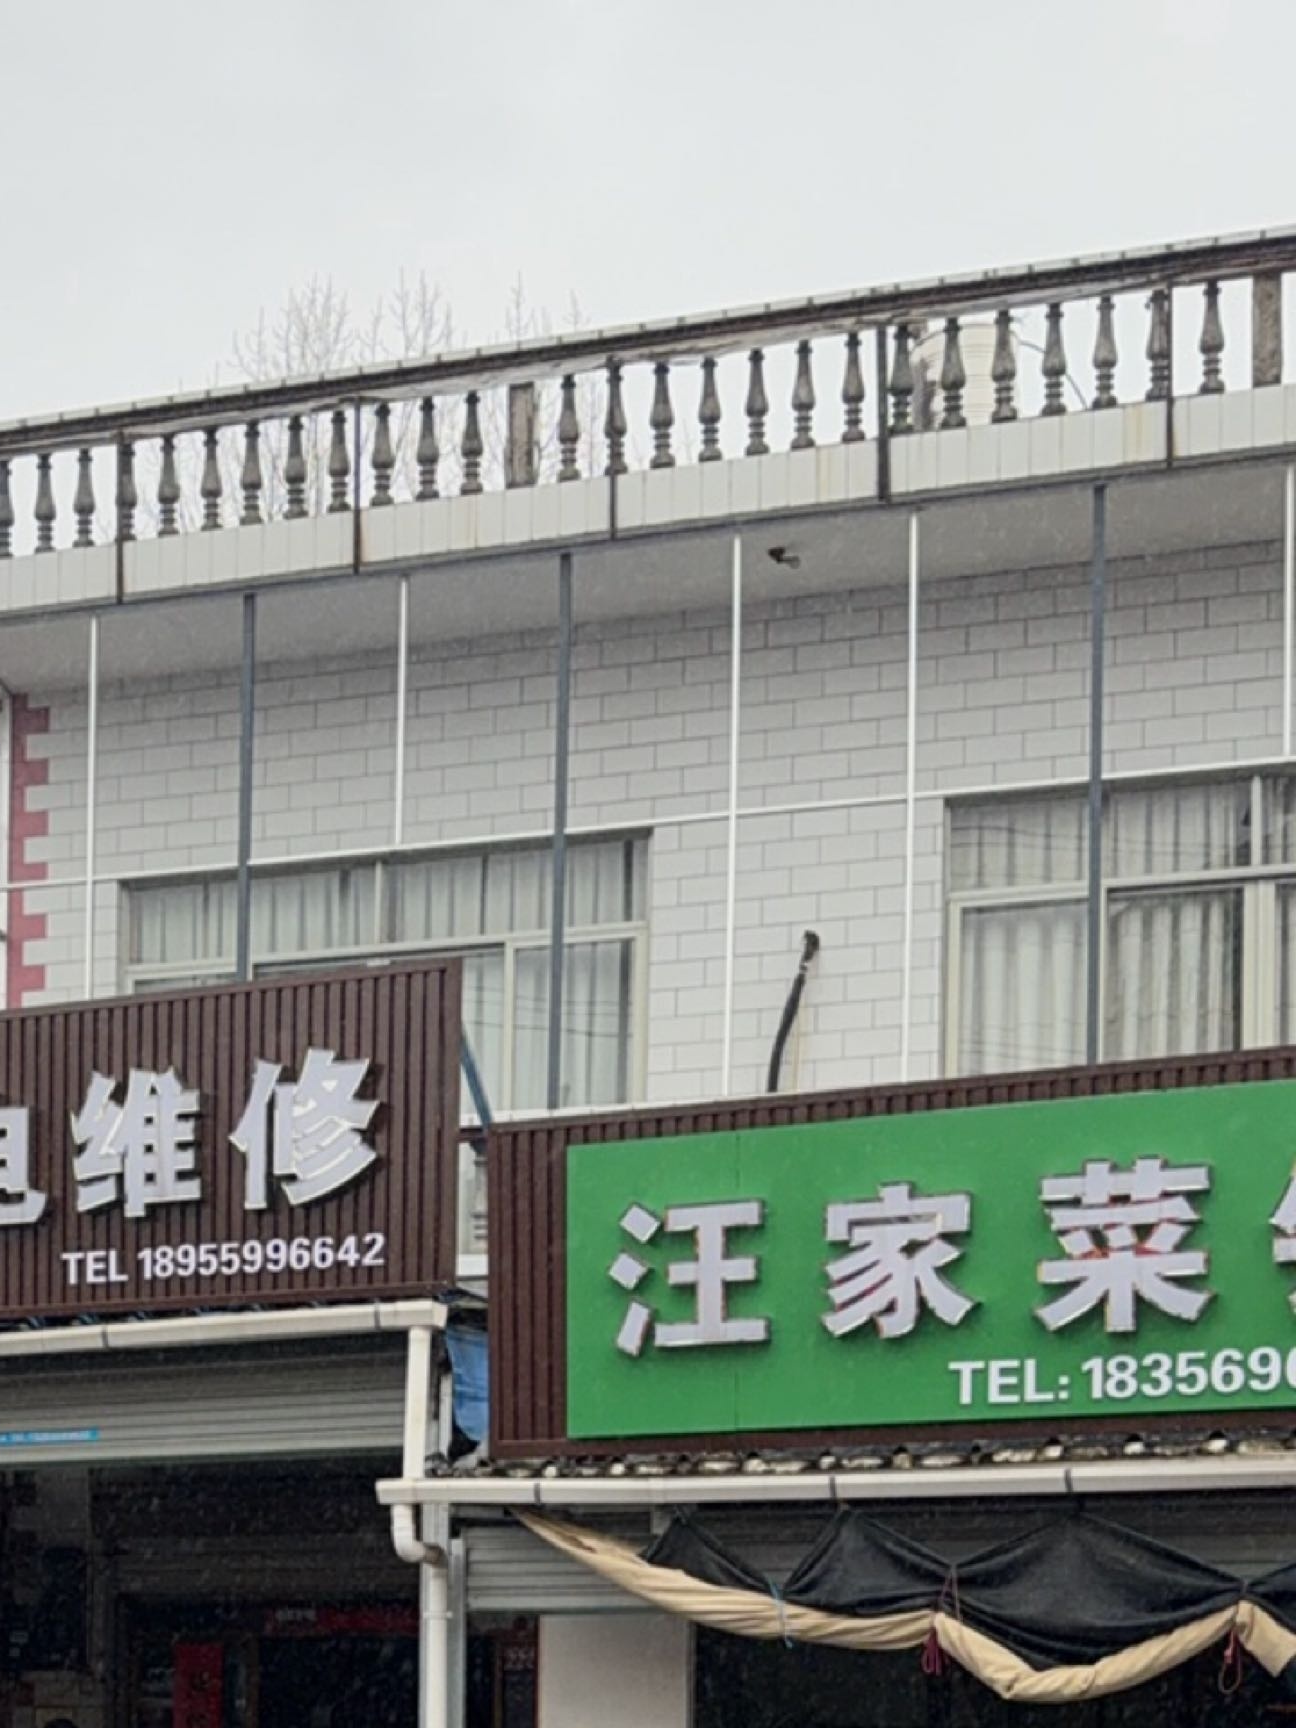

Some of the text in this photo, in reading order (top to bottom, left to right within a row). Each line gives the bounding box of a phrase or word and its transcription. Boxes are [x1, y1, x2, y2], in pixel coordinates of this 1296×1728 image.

[61, 1231, 386, 1285] TEL 18955996642
[607, 1155, 1296, 1358] 汪家菜
[948, 1358, 1071, 1405] TEL:
